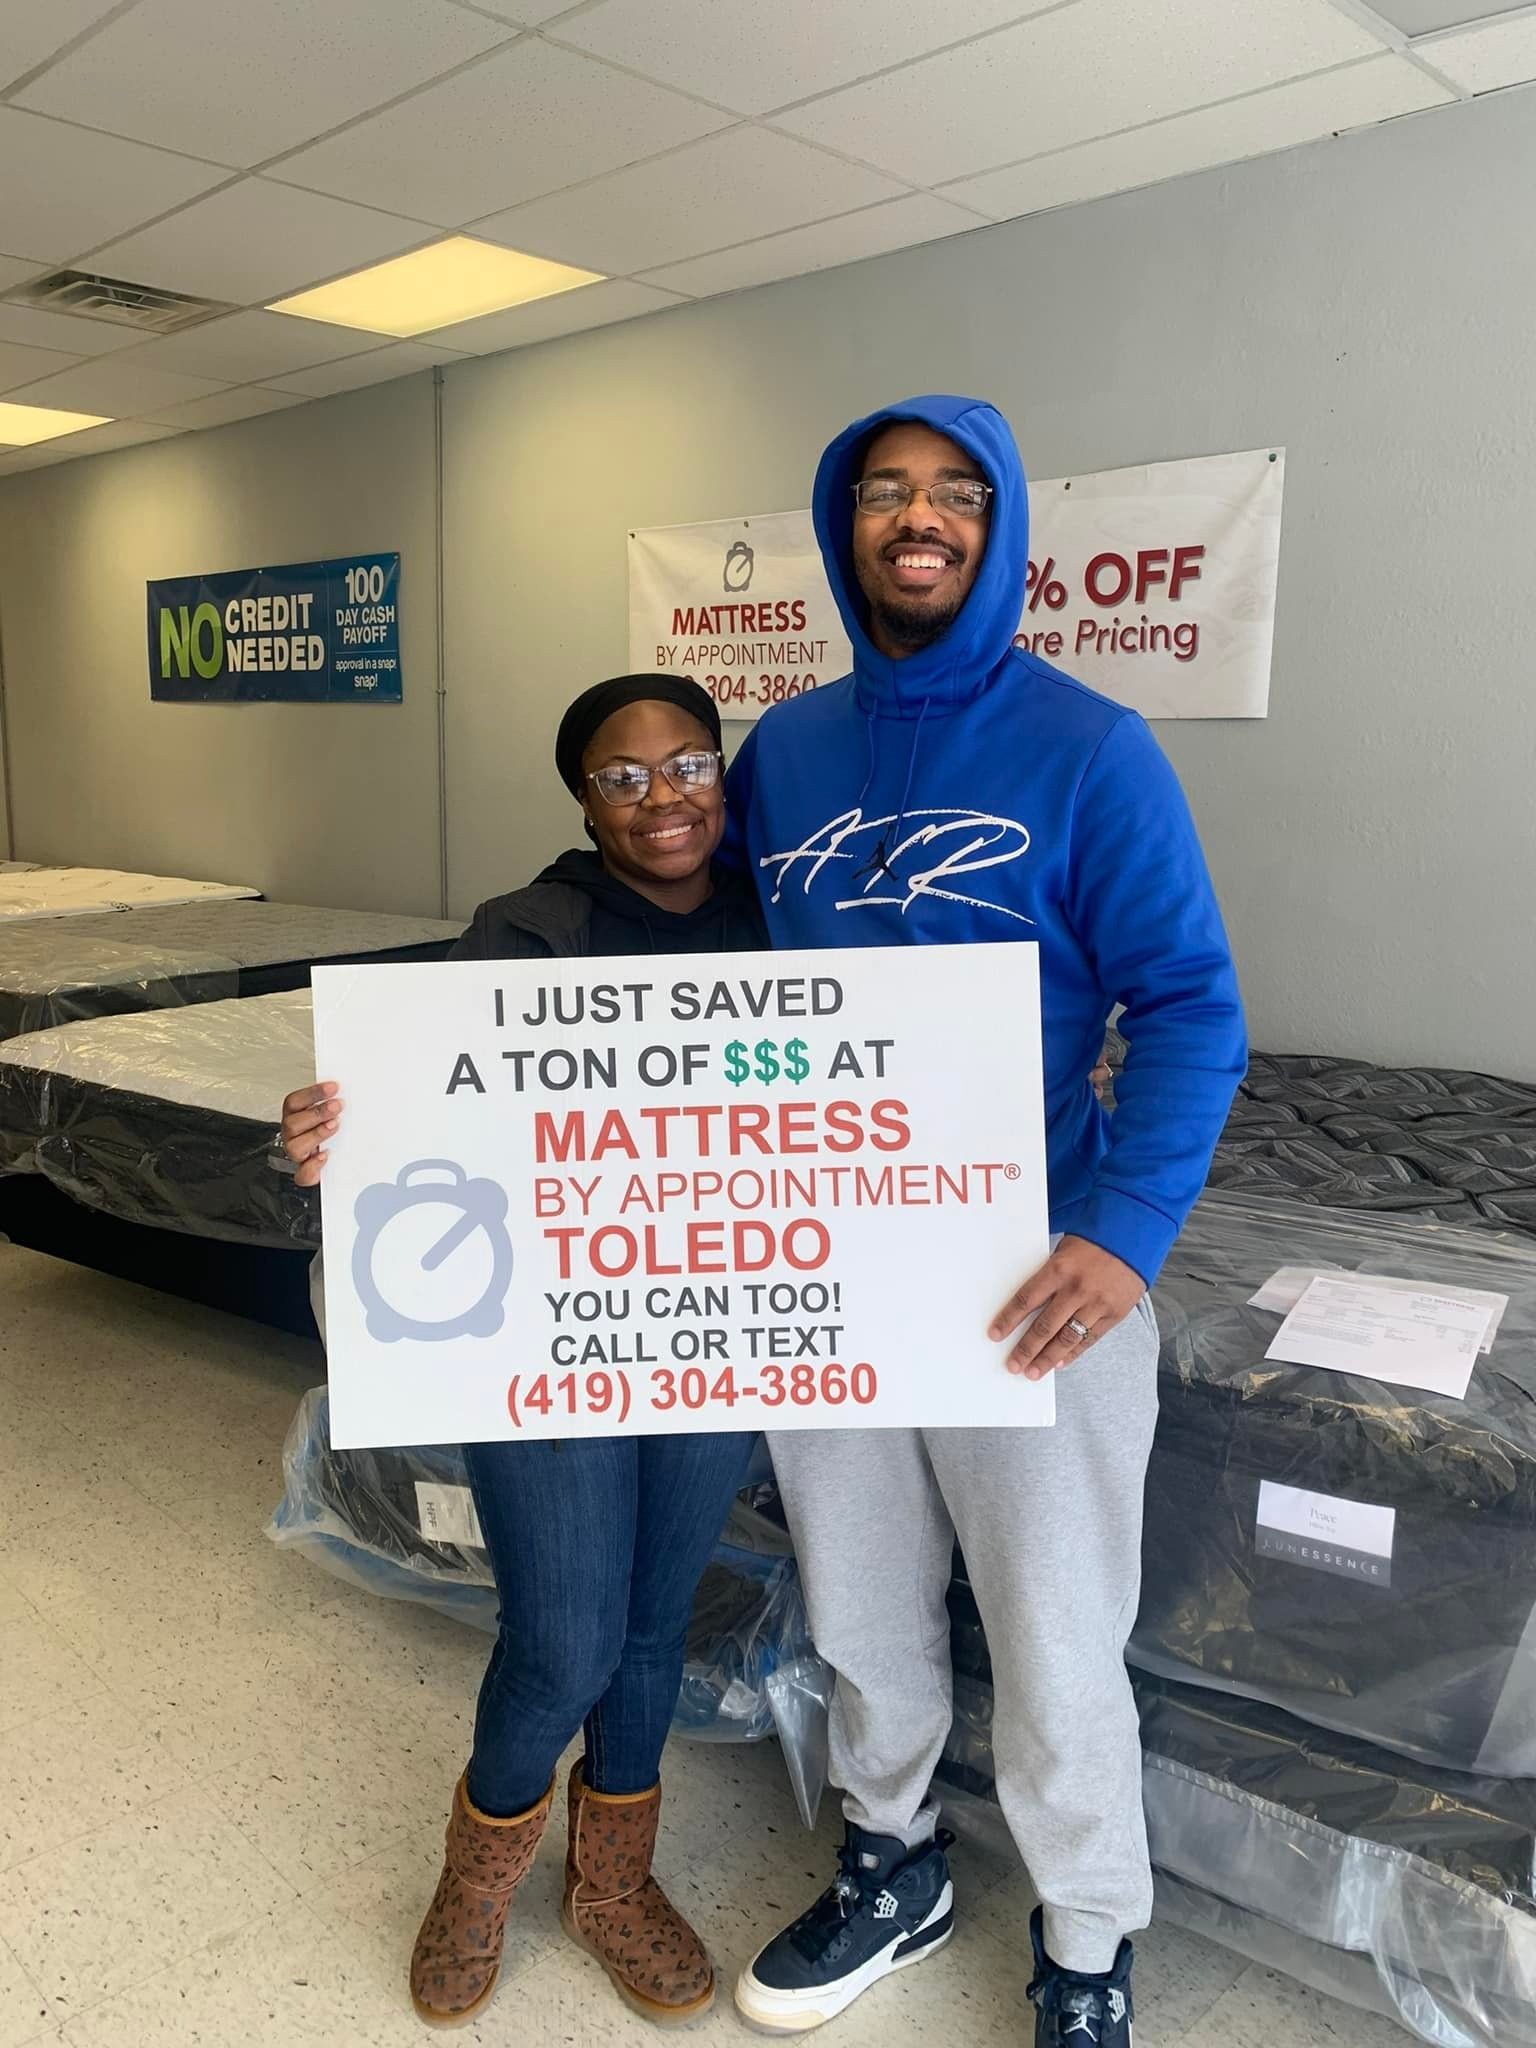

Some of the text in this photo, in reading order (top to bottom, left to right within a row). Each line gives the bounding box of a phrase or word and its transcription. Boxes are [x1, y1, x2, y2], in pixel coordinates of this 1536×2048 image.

[345, 565, 384, 605] 100
[1084, 545, 1205, 606] OFF
[225, 594, 313, 633] CREDIT
[336, 606, 395, 627] DAY CASH
[672, 600, 807, 636] MATTRESS
[160, 602, 223, 679] NO
[227, 635, 325, 673] NEEDED
[343, 625, 387, 645] PAYOFF
[656, 641, 828, 666] BY APPOINTMENT
[1074, 615, 1199, 661] Pricing
[336, 657, 364, 671] approval
[364, 657, 371, 669] in
[353, 675, 379, 692] snap!
[494, 977, 844, 1027] I JUST SAVED
[446, 1037, 895, 1095] A TON OF $$$ AT
[534, 1099, 911, 1163] MATTRESS
[536, 1175, 602, 1218] BY
[543, 1219, 831, 1279] TOLEDO
[544, 1283, 841, 1323] YOU CAN TOO!
[551, 1326, 844, 1366] CALL OR TEXT
[507, 1363, 877, 1427] (419) 304-3860
